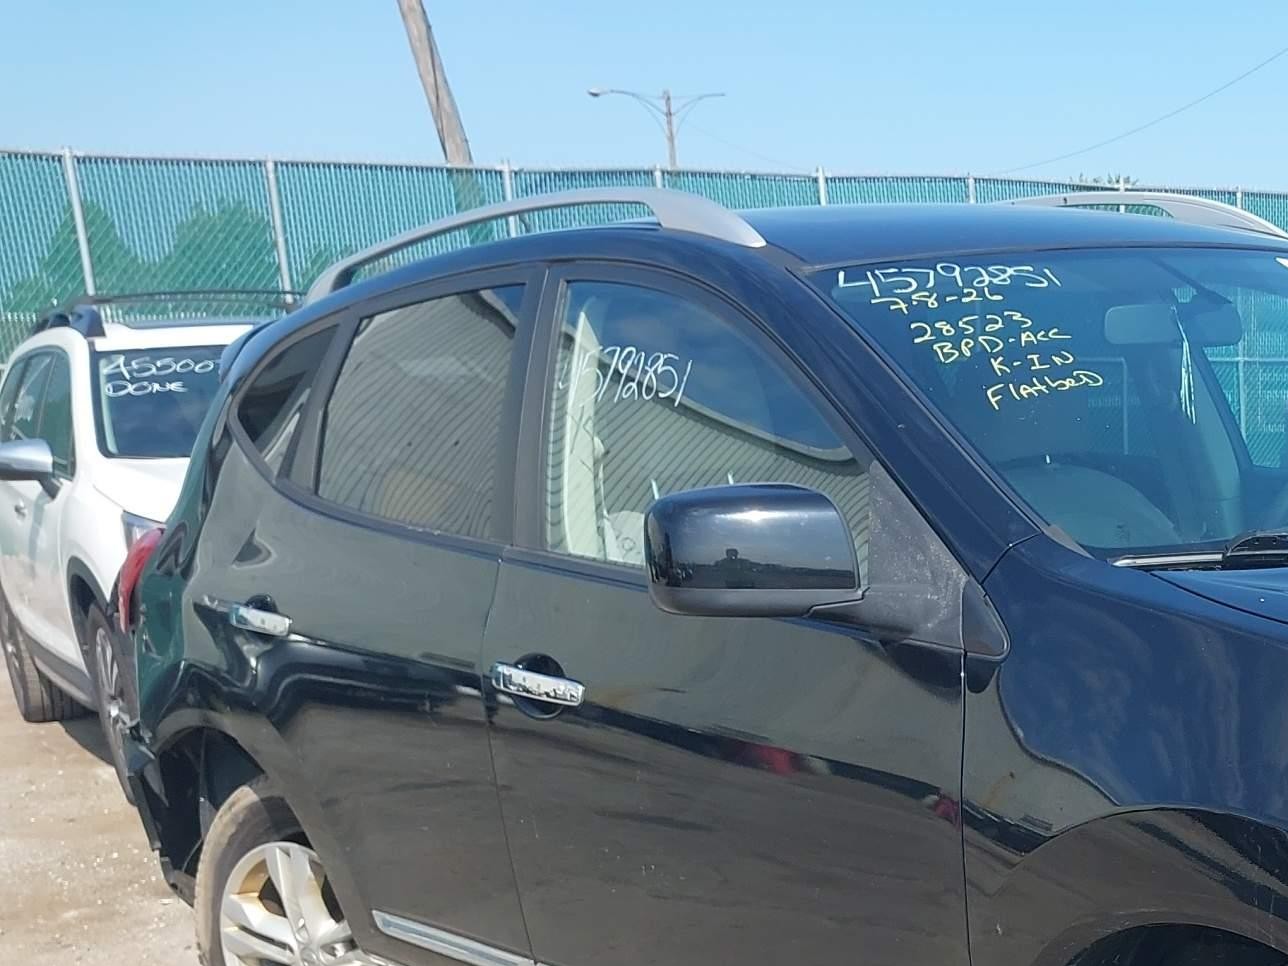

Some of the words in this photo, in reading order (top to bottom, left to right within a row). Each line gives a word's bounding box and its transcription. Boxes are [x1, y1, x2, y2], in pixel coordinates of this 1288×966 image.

[837, 263, 1062, 297] 45792851
[910, 311, 1033, 344] 28523
[103, 354, 220, 380] 45500
[105, 380, 188, 397] DONE
